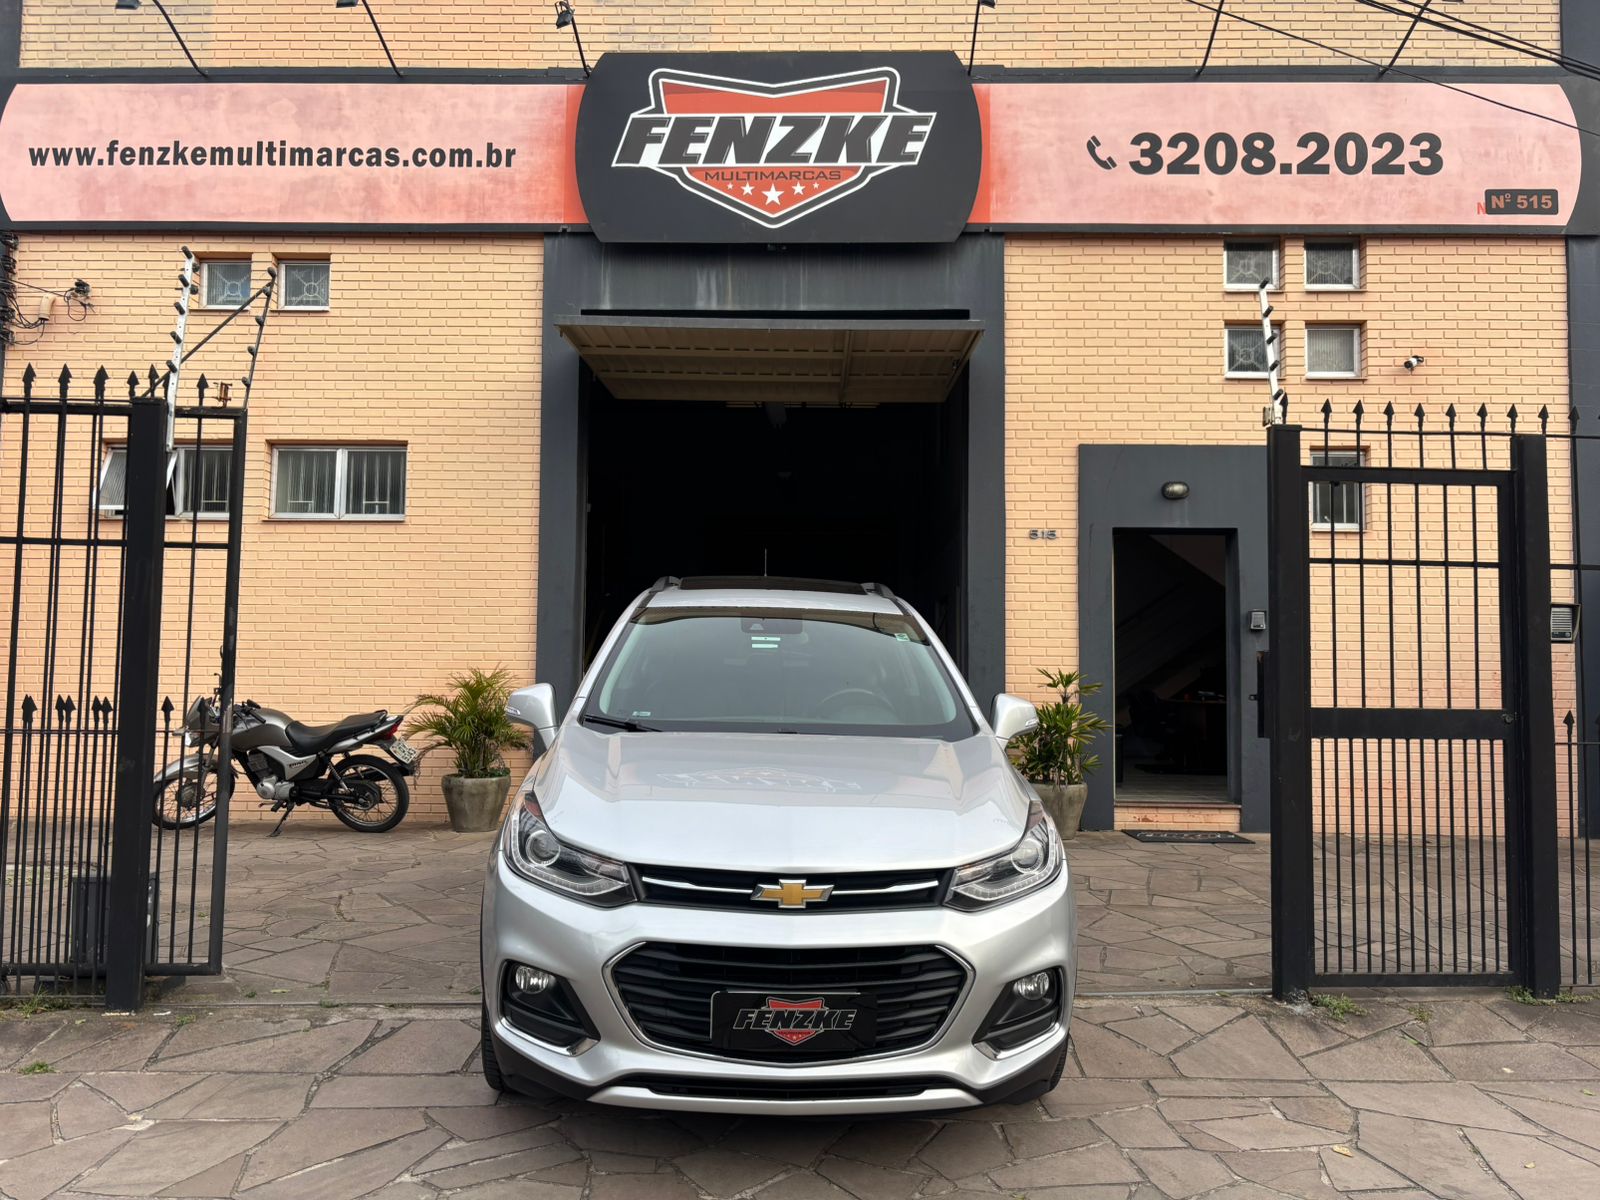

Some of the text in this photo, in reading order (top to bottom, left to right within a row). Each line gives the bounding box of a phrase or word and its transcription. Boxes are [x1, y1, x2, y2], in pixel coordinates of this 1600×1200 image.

[613, 114, 935, 166] FENZKE
[28, 140, 517, 168] www.fenzkemultimarcas.com.br
[1128, 131, 1444, 176] 3208.2023
[704, 170, 841, 181] MULTIMARCAS
[1516, 194, 1553, 209] 515
[733, 1009, 857, 1030] FENZKE
